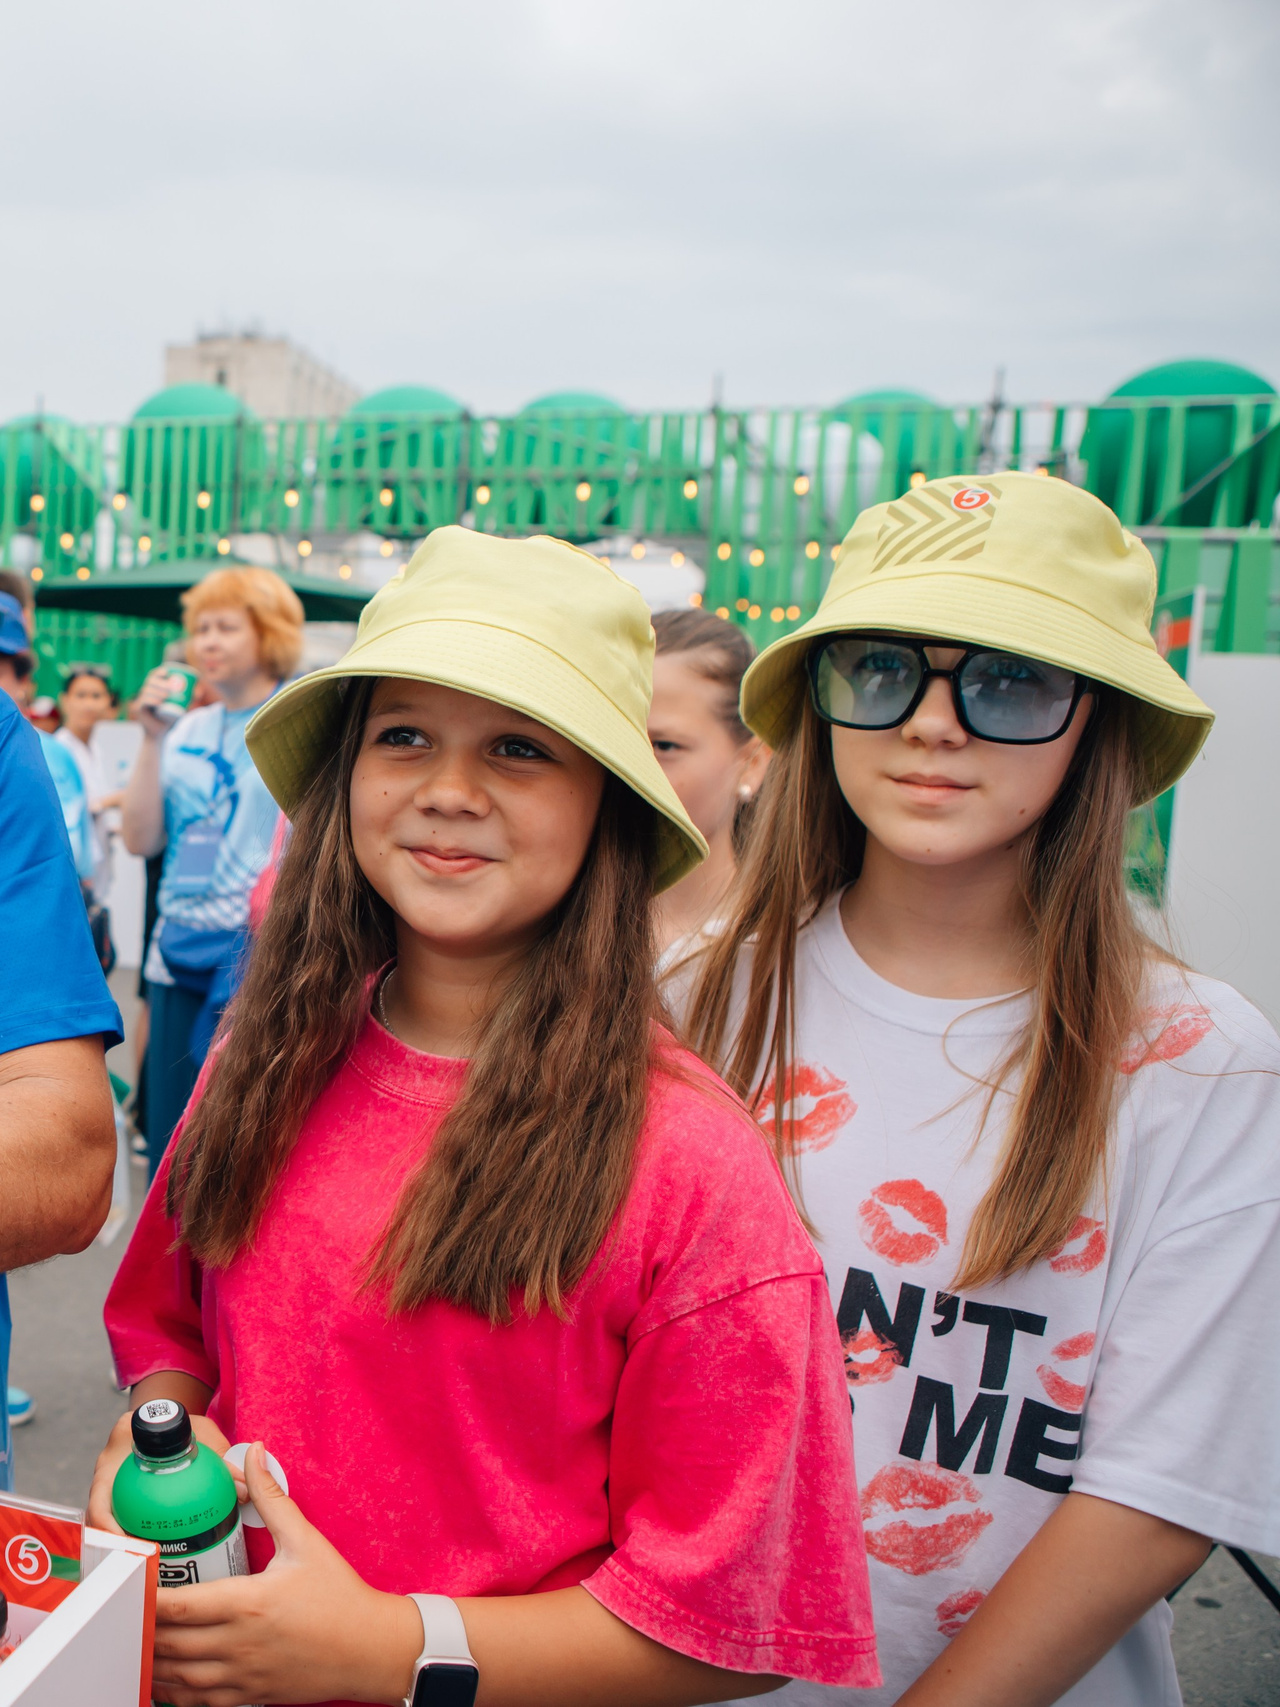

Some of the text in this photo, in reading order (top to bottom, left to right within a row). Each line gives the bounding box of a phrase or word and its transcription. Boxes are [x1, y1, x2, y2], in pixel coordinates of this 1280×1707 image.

[827, 1266, 1048, 1391] N'T
[888, 1374, 1082, 1495] ME
[159, 1542, 188, 1553] МИКС
